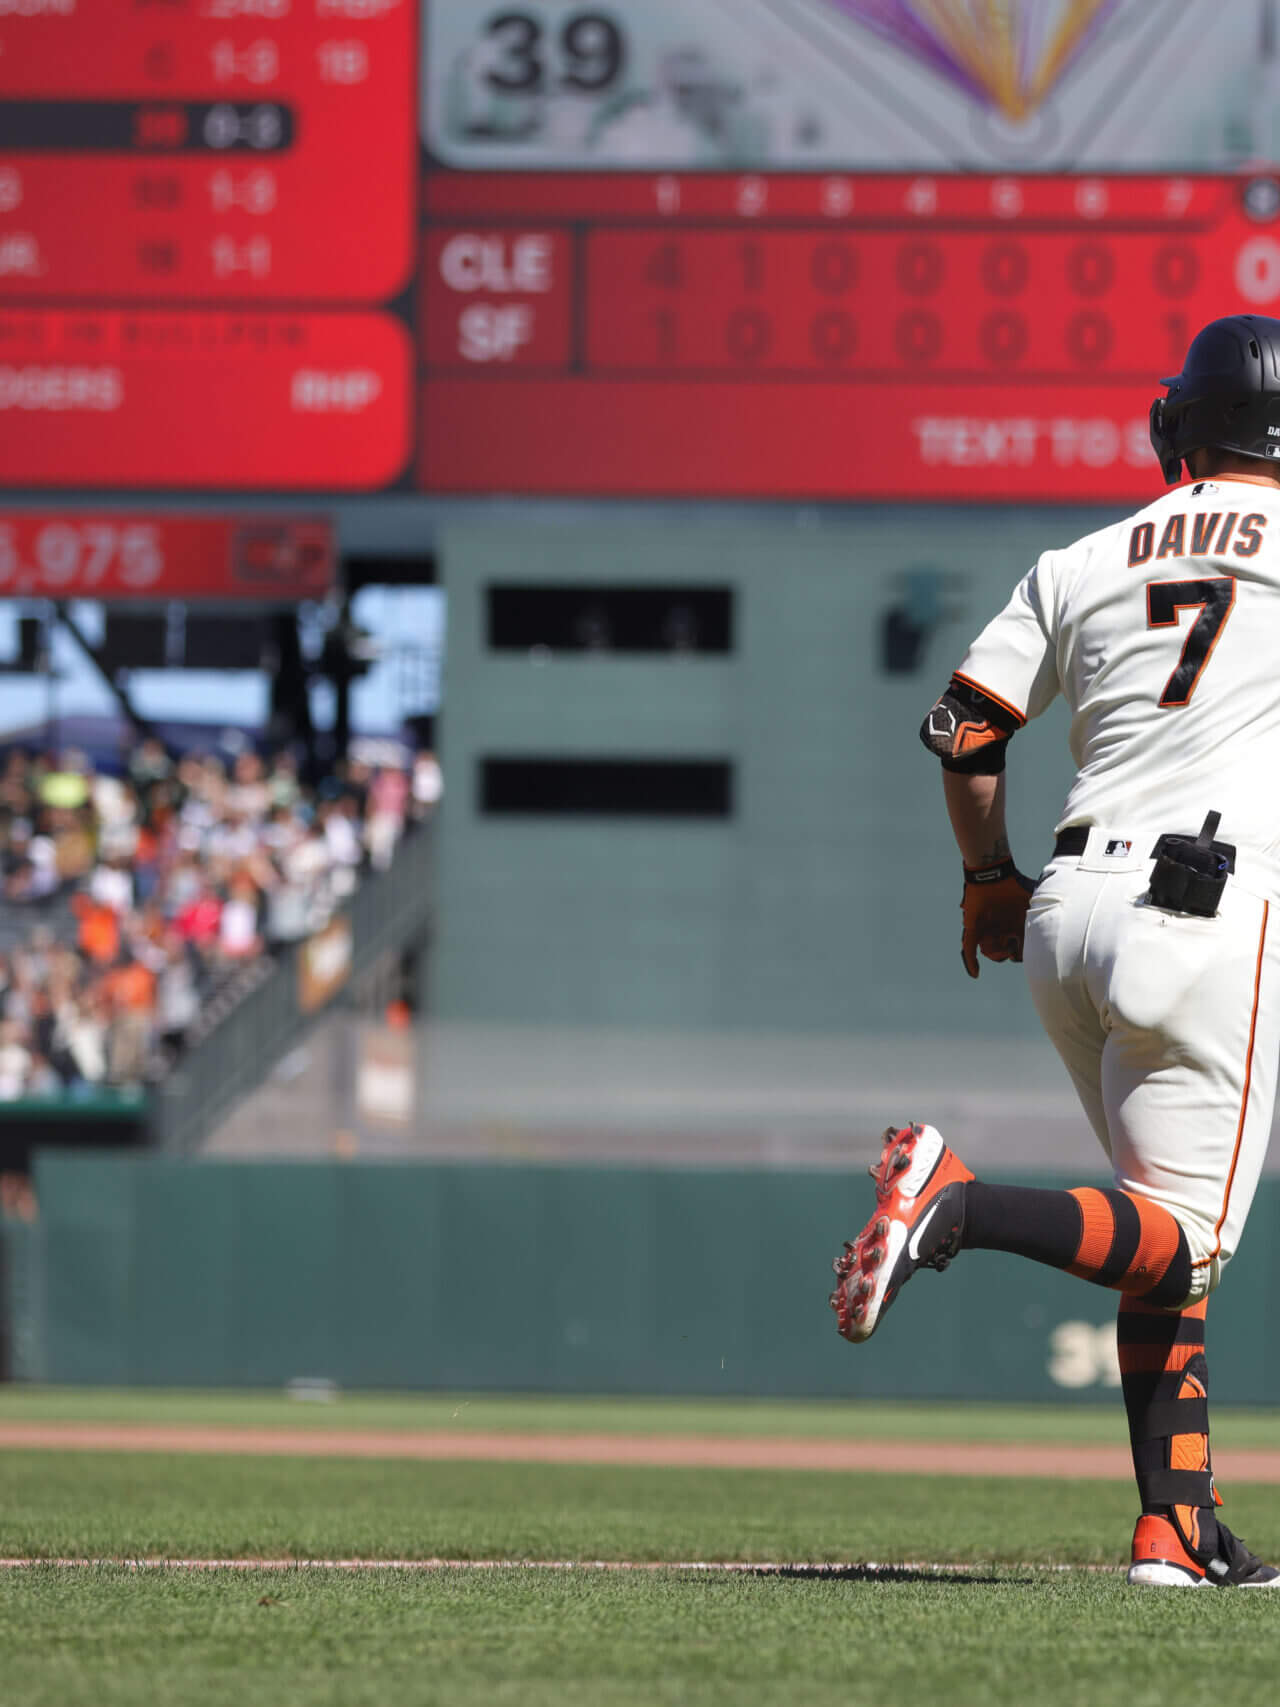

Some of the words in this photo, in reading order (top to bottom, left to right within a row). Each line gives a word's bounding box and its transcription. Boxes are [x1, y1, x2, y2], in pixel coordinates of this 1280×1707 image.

[484, 12, 626, 93] 39
[440, 234, 552, 292] CLE
[811, 242, 860, 295] 0
[896, 242, 944, 297] 0
[981, 242, 1030, 297] 0
[1067, 242, 1115, 297] 0
[1152, 243, 1199, 298] 0
[458, 304, 533, 361] SF
[725, 309, 774, 362] 0
[811, 309, 859, 362] 0
[896, 309, 944, 362] 0
[980, 309, 1029, 362] 0
[1066, 309, 1114, 362] 0
[917, 417, 1038, 466] TEXT
[1052, 419, 1121, 467] TO
[1128, 512, 1268, 568] DAVIS
[1146, 575, 1237, 708] 7
